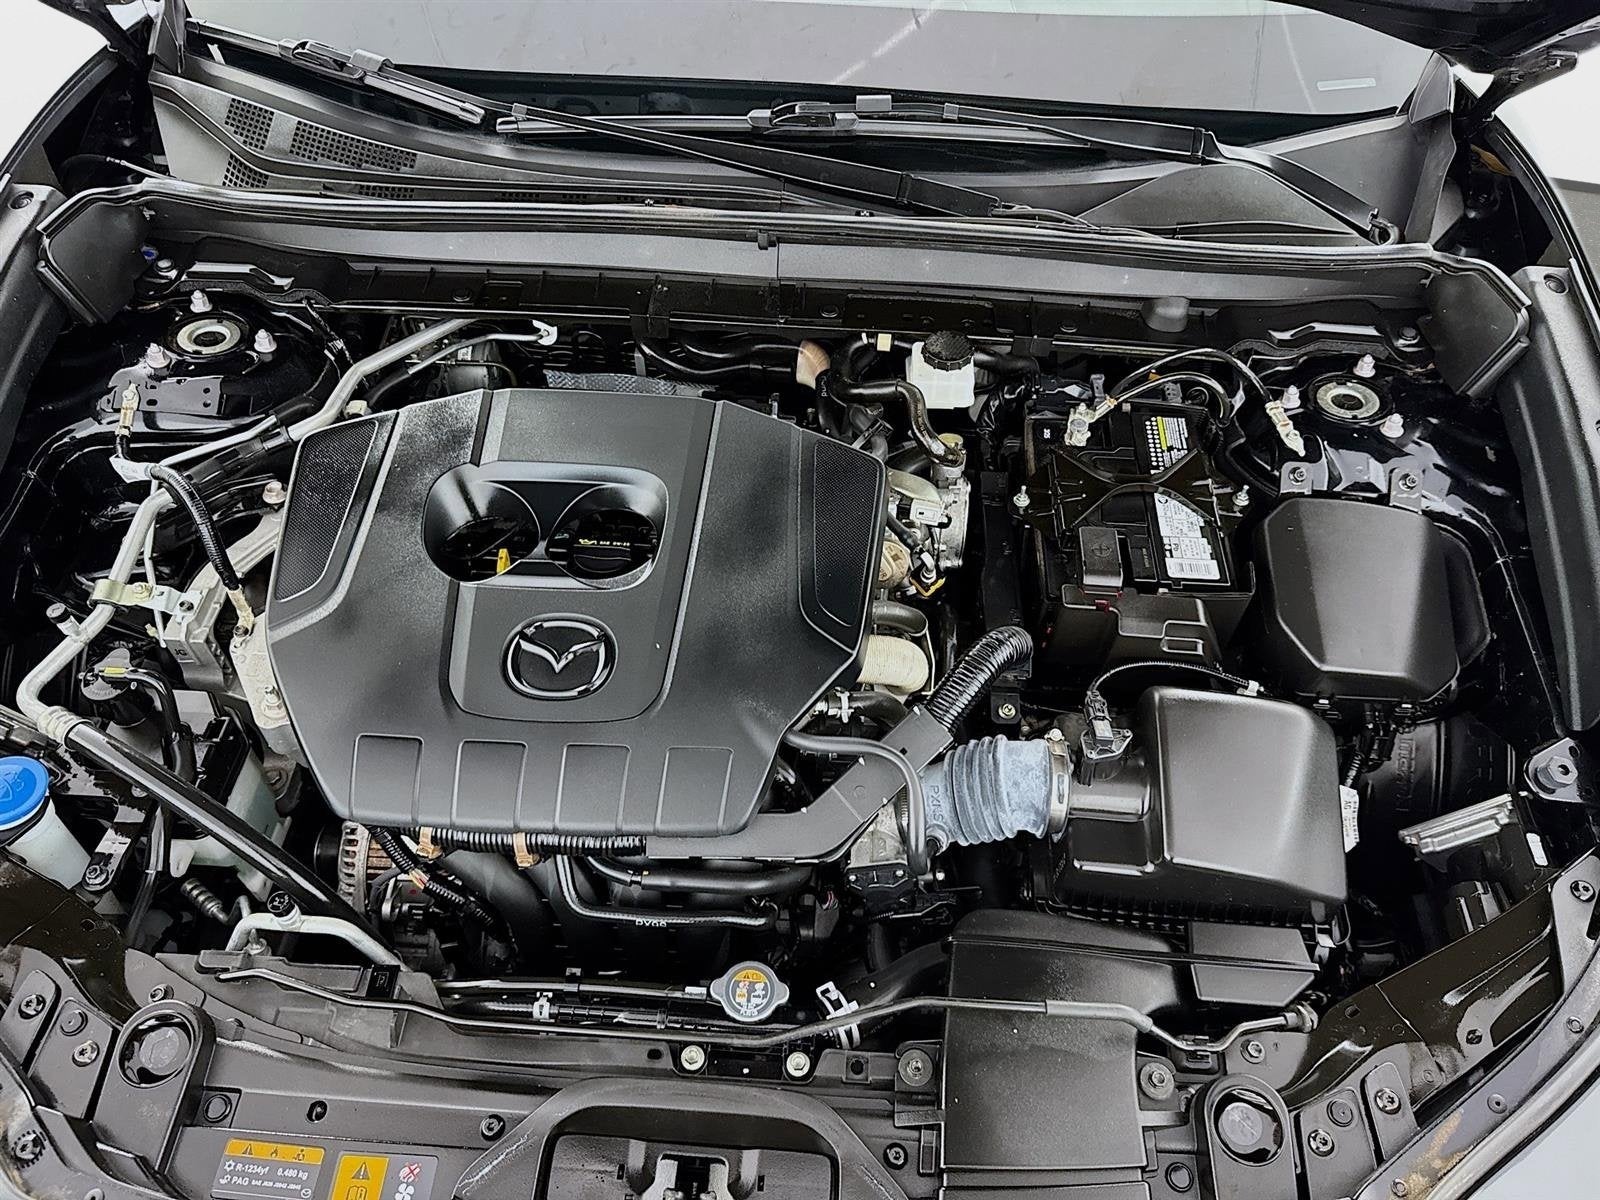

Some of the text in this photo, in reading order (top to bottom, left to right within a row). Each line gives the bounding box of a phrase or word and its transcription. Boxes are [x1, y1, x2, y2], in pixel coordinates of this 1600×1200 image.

[236, 1163, 269, 1175] R-1234yf
[298, 1170, 308, 1180] kg
[231, 1176, 249, 1185] PAG
